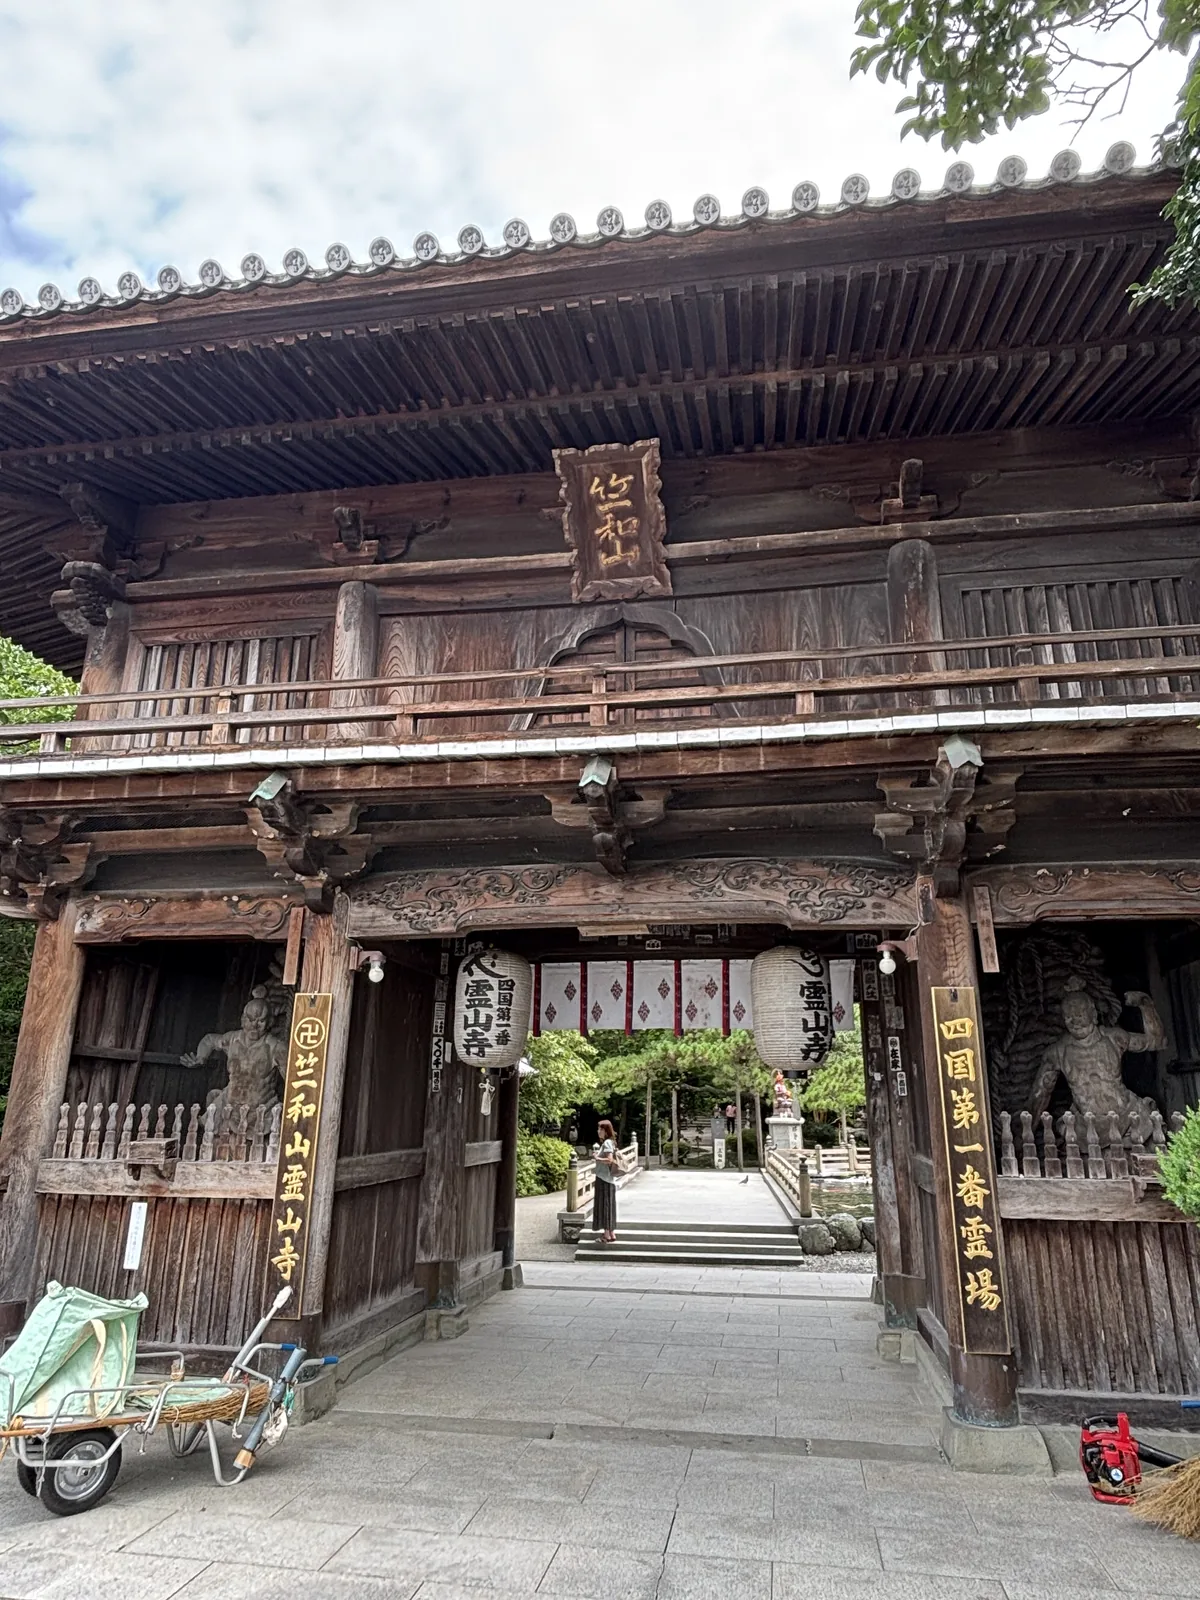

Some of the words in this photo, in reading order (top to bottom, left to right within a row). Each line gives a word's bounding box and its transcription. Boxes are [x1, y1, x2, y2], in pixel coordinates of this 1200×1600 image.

[590, 473, 640, 567] 竺和山
[463, 979, 495, 1058] 霊山寺
[495, 979, 516, 1046] 四国第一番
[800, 980, 829, 1063] 霊山寺
[271, 1054, 318, 1280] 竺和山霊山寺
[940, 1017, 1001, 1311] 四国第一番霊場
